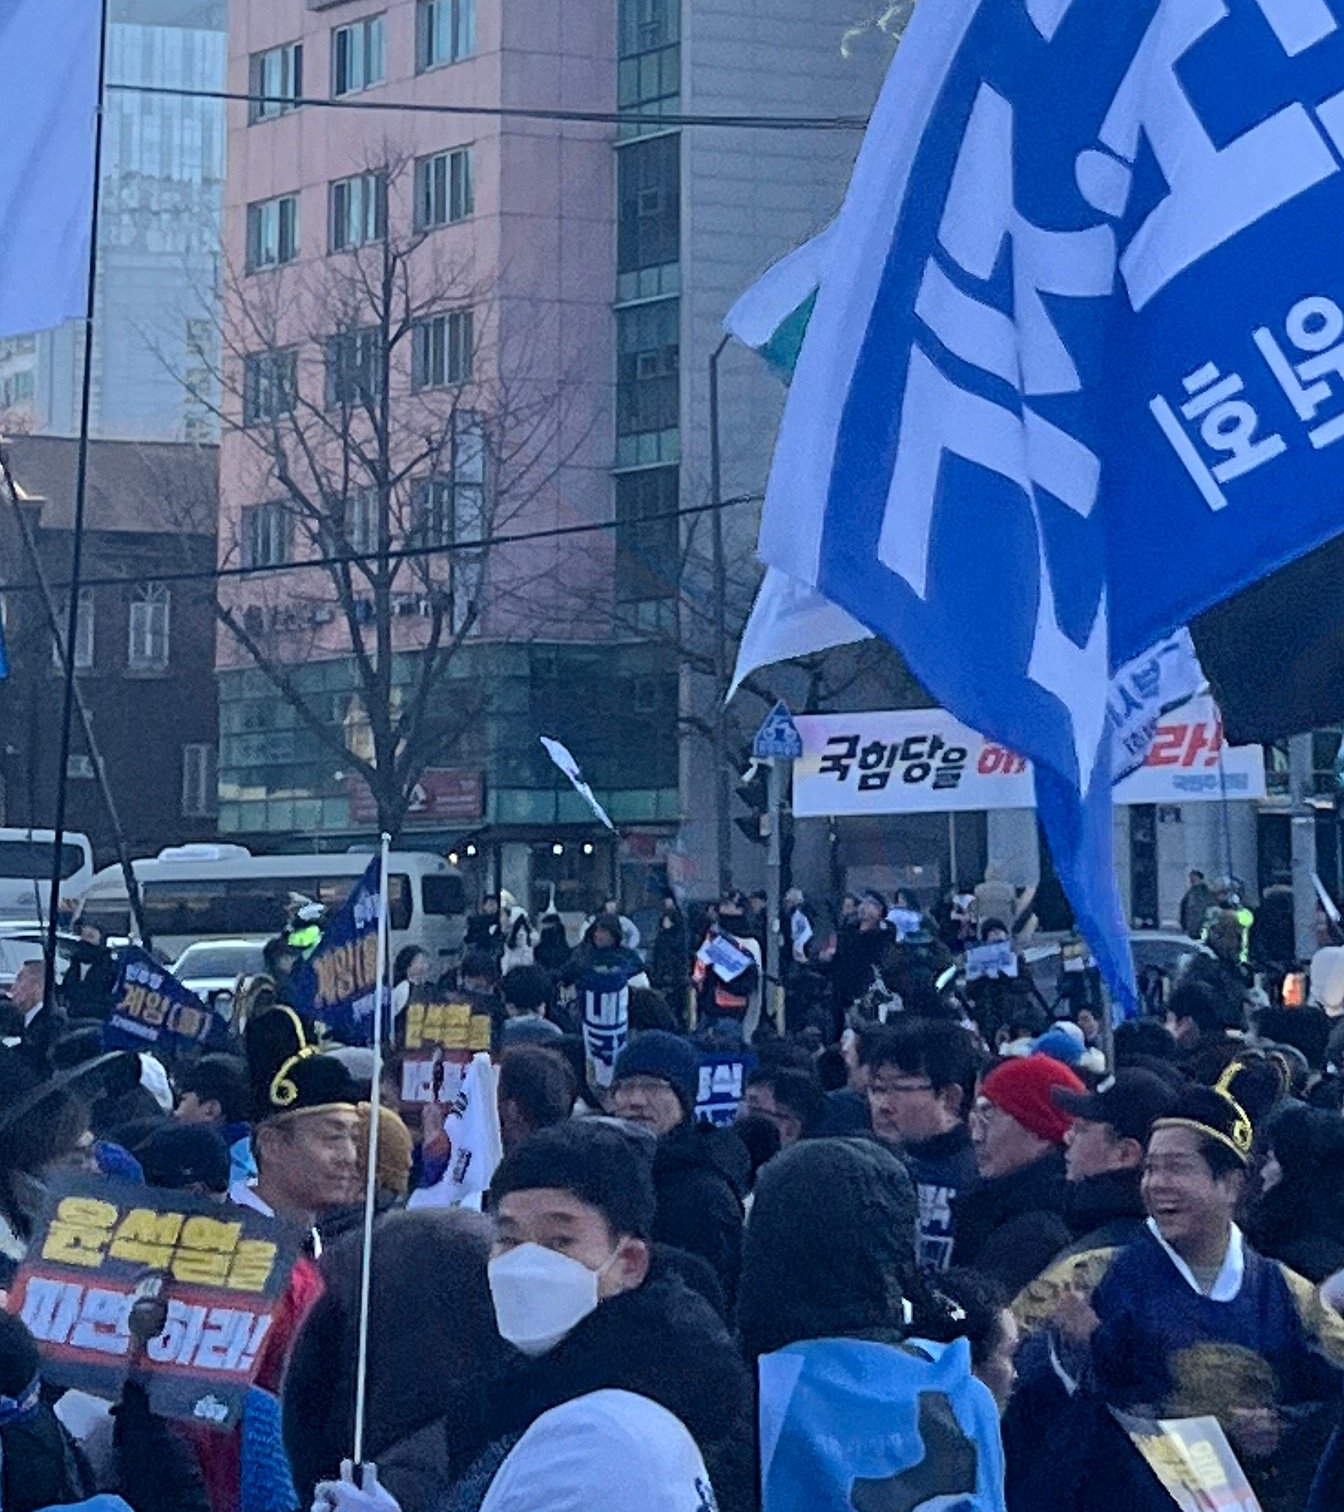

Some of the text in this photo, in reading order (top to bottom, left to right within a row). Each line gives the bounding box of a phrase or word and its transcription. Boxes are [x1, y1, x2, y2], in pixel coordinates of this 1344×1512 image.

[818, 731, 969, 791] 국힘당을
[41, 1195, 278, 1293] 윤석열을
[20, 1276, 272, 1372] 파면하라!
